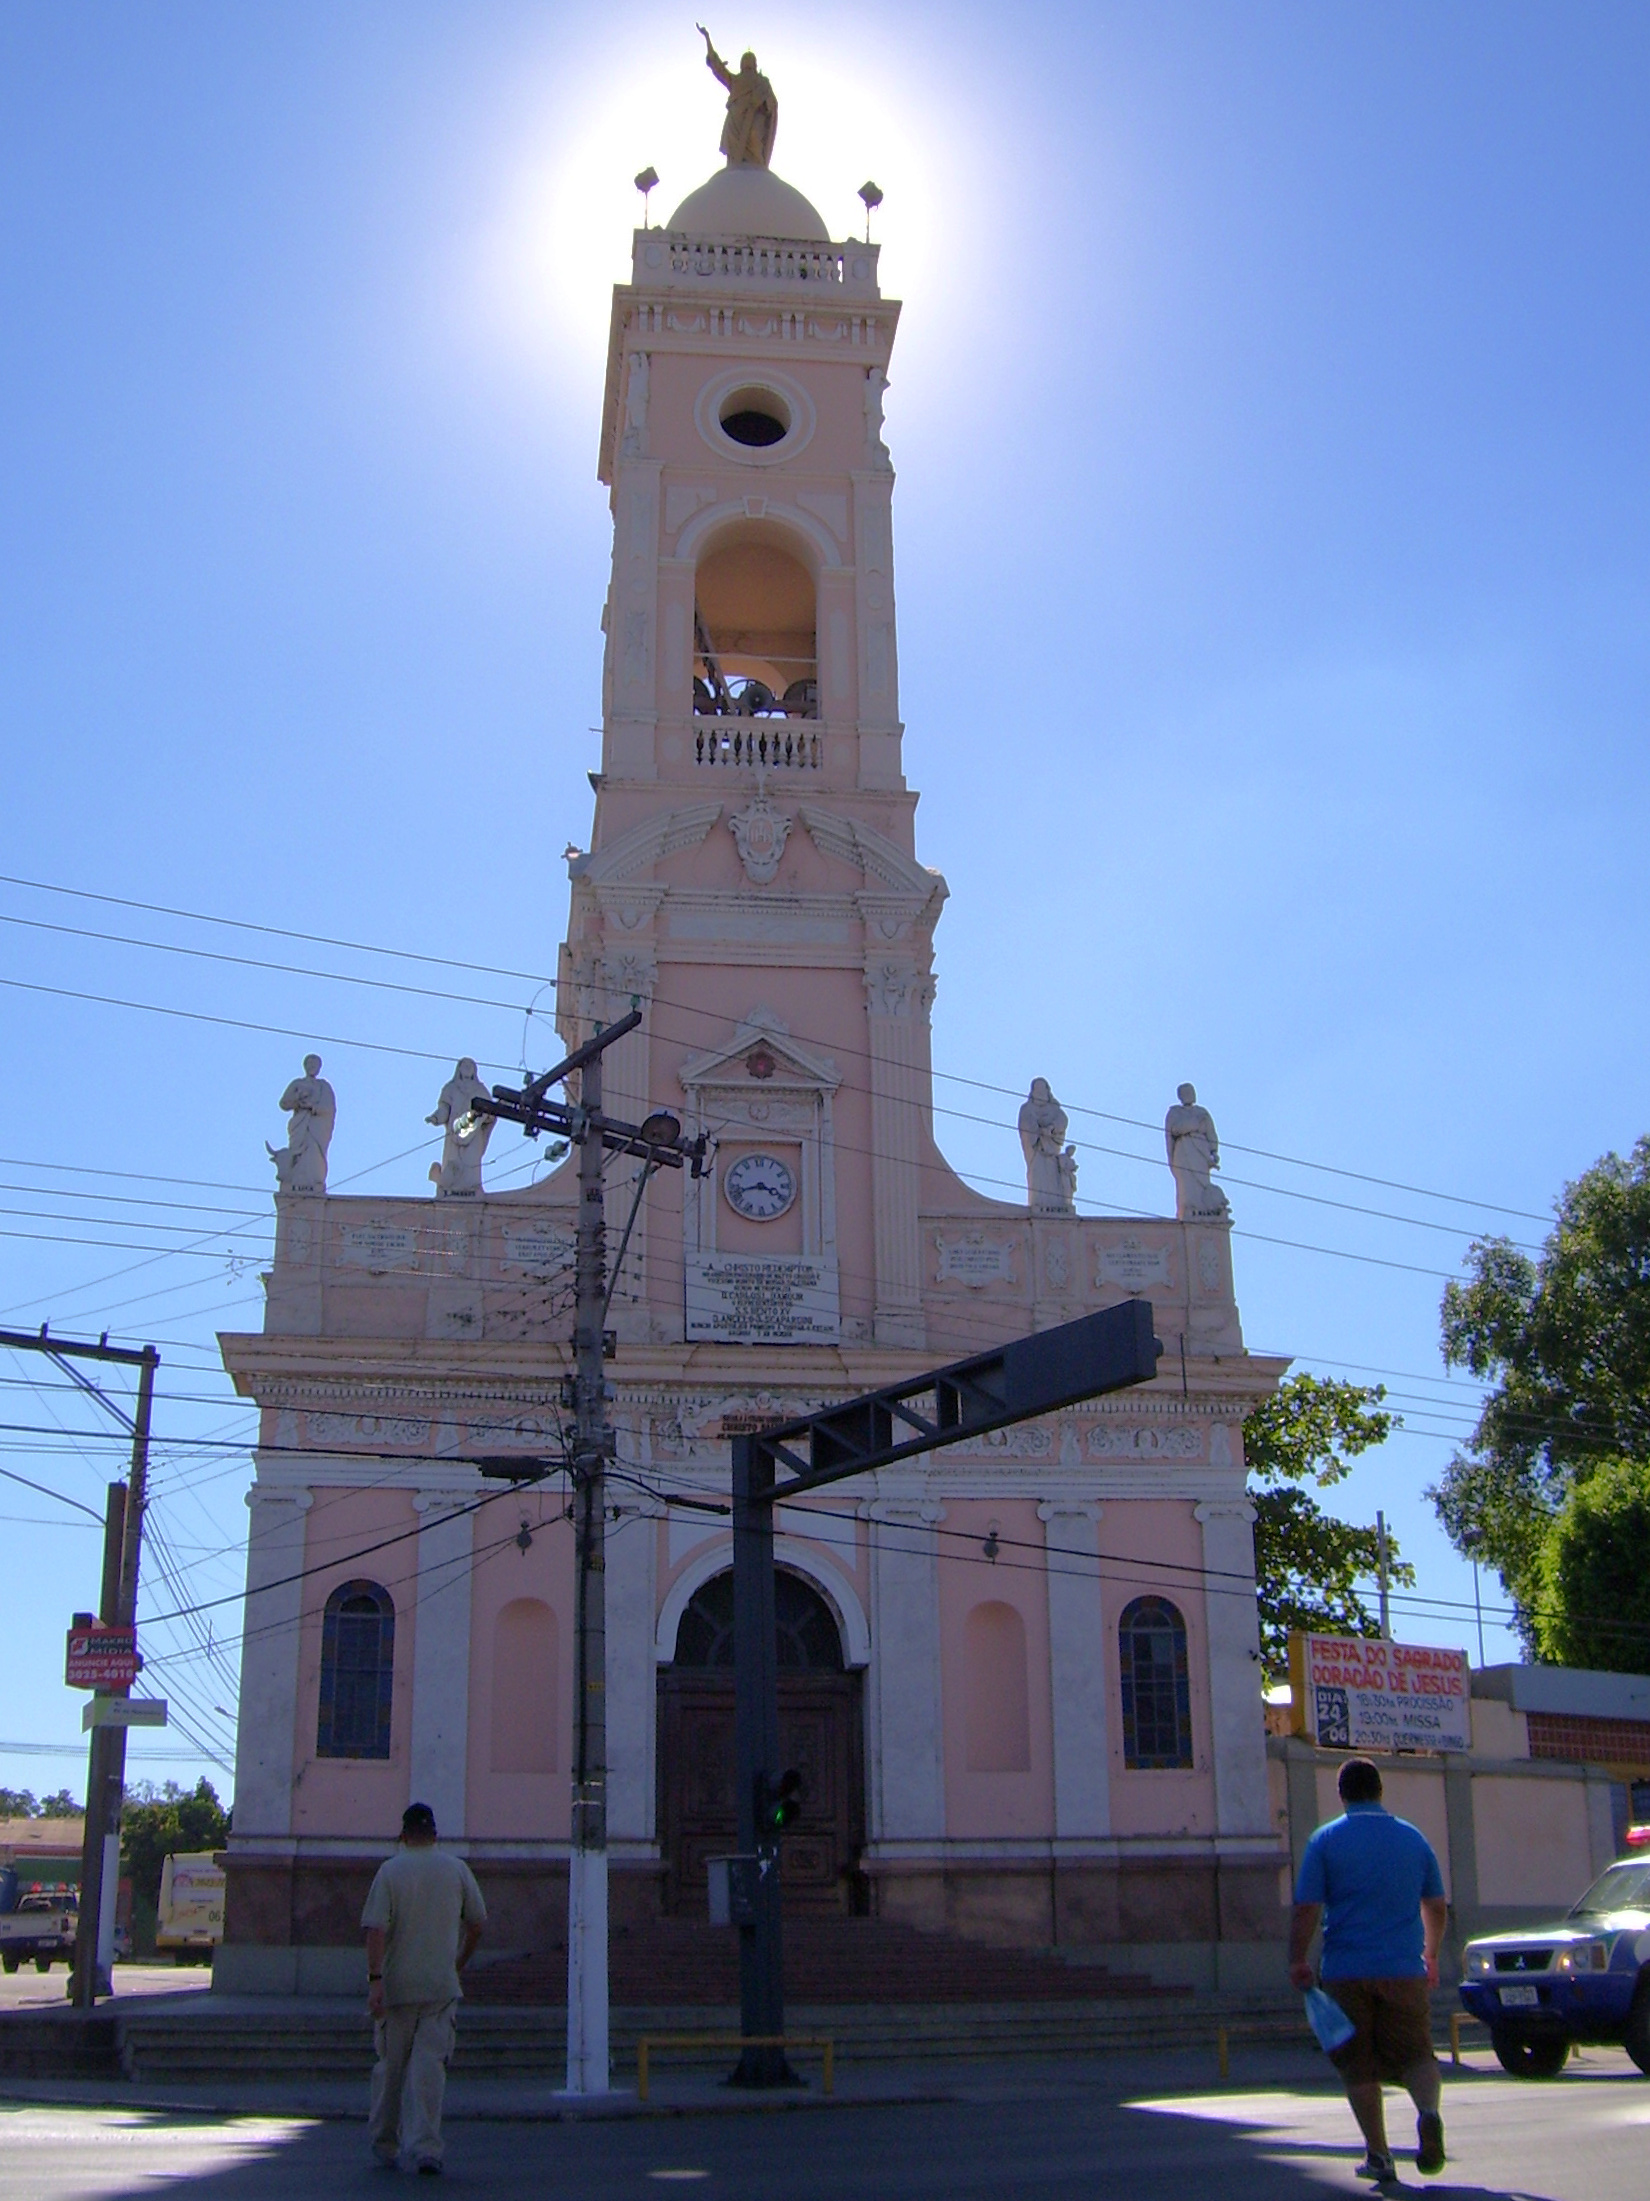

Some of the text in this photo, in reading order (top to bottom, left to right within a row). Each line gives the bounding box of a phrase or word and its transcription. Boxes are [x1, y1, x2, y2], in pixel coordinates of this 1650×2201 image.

[69, 1659, 133, 1667] ANUNCIE AQUI
[1311, 1640, 1462, 1672] FESTA DO SAGRADO
[1312, 1665, 1462, 1696] CORAÇÃO DE JESUS
[1397, 1695, 1454, 1712] PROCISSÃO
[1403, 1713, 1441, 1729] MISSA
